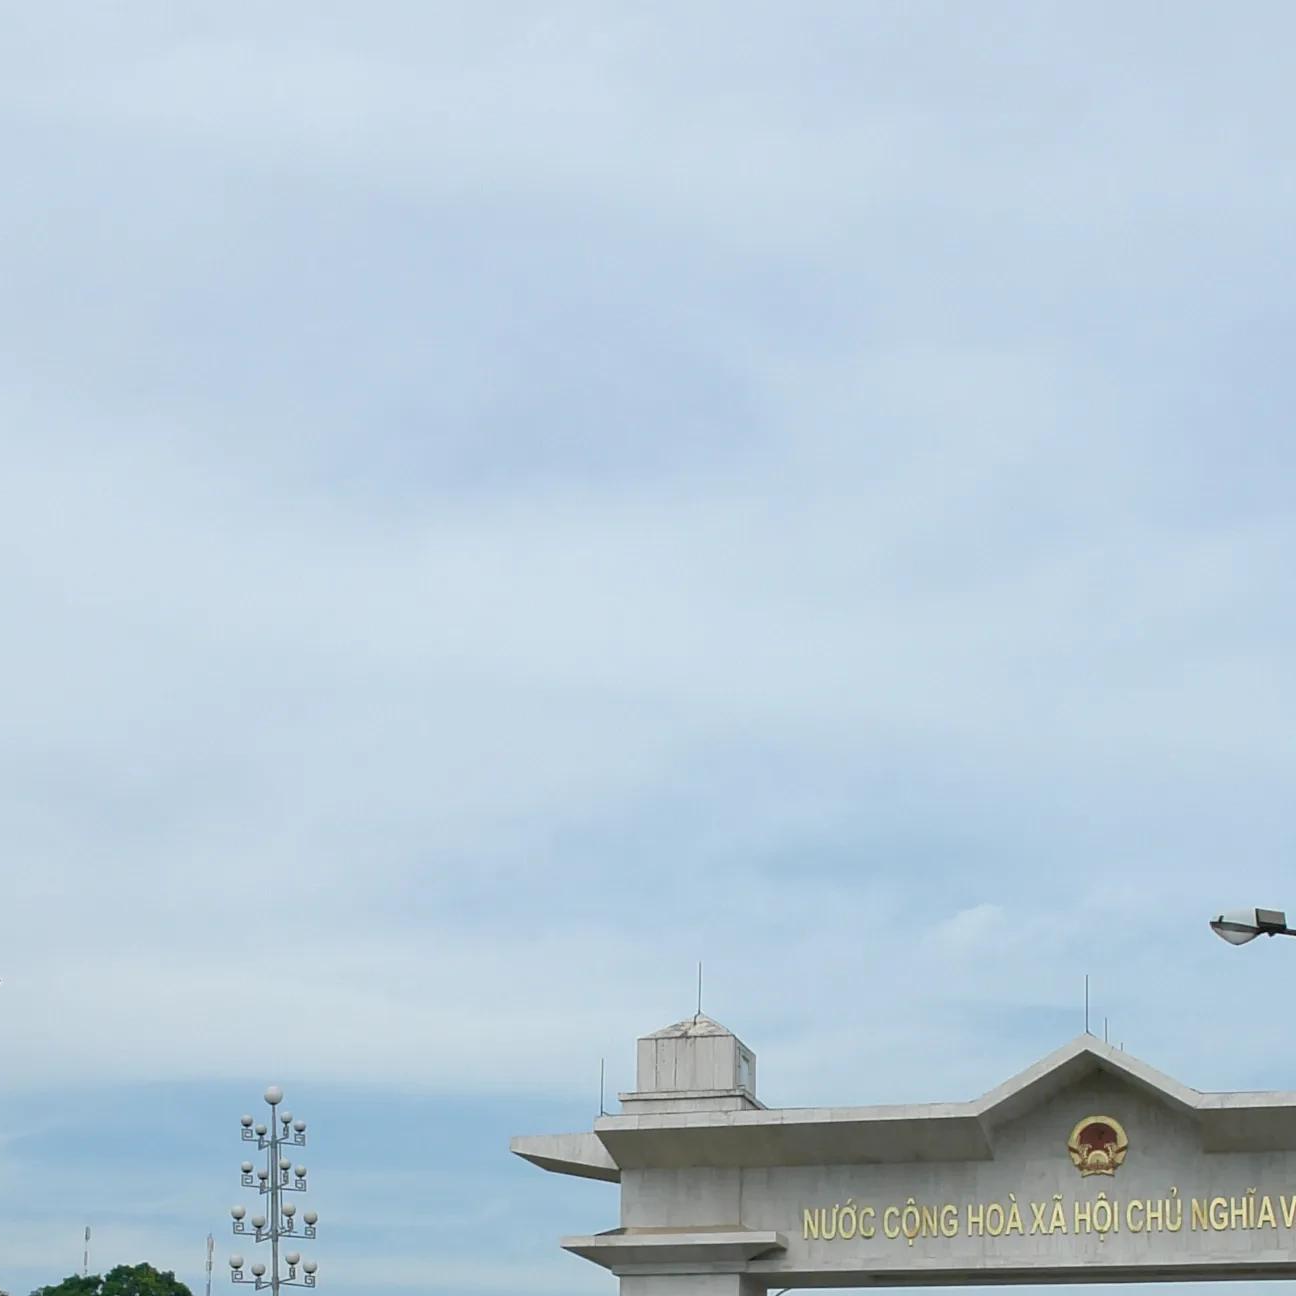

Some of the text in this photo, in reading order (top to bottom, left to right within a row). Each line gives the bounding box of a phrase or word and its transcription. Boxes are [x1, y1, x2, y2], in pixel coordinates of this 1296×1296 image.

[803, 1198, 875, 1240] NƯỚC
[884, 1197, 959, 1247] CỘNG
[967, 1193, 1025, 1238] HOÀ
[1029, 1194, 1068, 1236] XÃ
[1074, 1191, 1119, 1242] HỘI
[1126, 1187, 1182, 1233] CHỦ
[1191, 1187, 1277, 1232] NGHĨA
